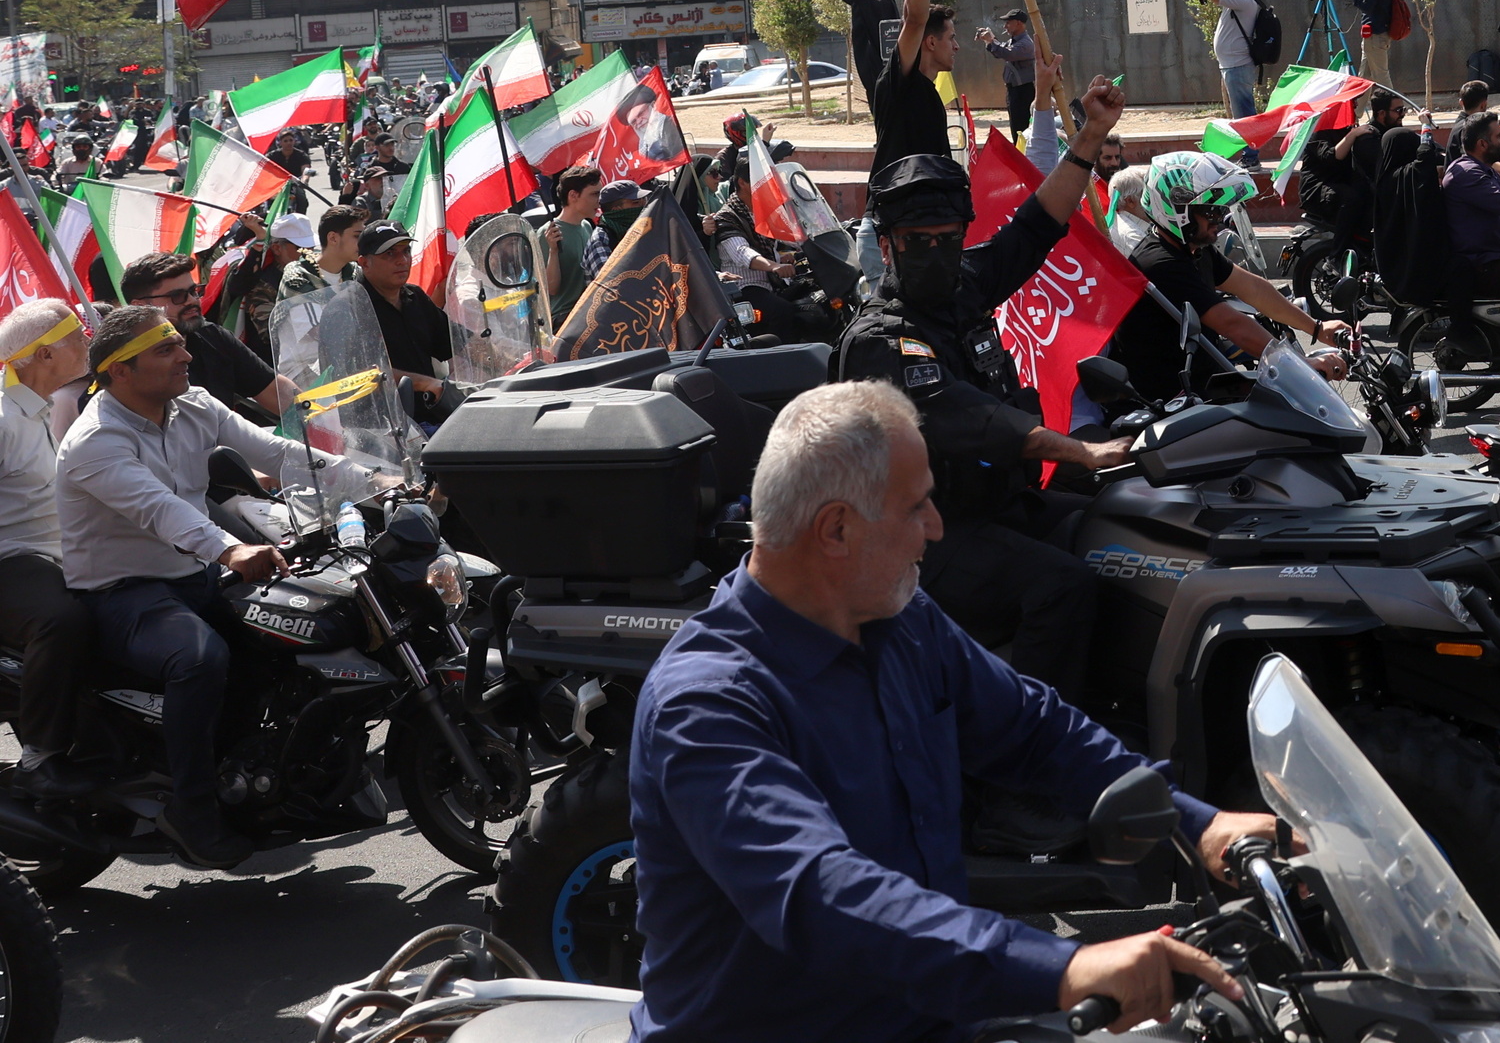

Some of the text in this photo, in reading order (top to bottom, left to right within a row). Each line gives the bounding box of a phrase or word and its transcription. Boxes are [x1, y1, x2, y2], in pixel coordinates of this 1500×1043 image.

[388, 12, 412, 22] کتاب
[632, 11, 664, 28] کتاب
[667, 7, 704, 25] آژانس
[912, 366, 934, 379] A+
[1084, 549, 1206, 572] CFORCE
[1139, 569, 1183, 581] OVERL
[243, 602, 316, 639] Benelli
[603, 614, 685, 631] CFMOTO
